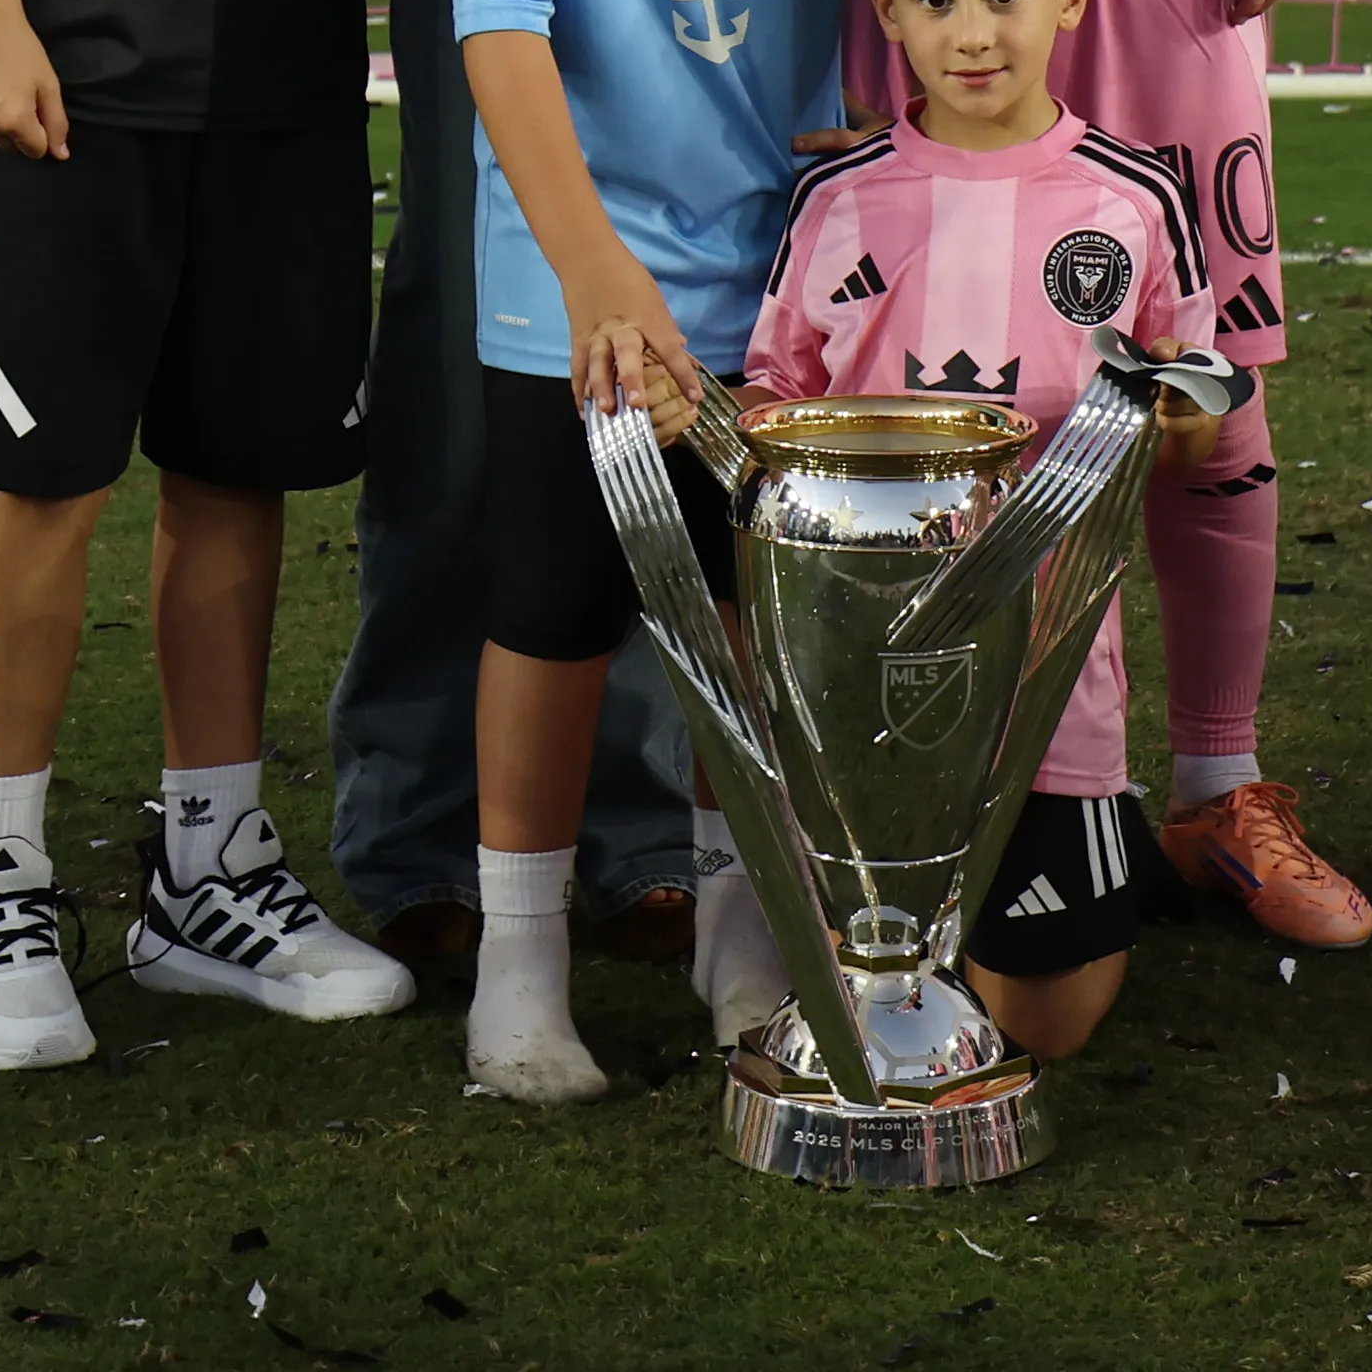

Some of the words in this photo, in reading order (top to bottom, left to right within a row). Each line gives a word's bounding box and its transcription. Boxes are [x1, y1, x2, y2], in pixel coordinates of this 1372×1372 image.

[1047, 234, 1120, 270] INTERNACIONAL
[1072, 255, 1109, 266] MIAMI
[1118, 254, 1129, 266] DE
[1046, 274, 1059, 301] CLUB
[1071, 312, 1099, 323] MMXX
[889, 664, 940, 687] MLS
[858, 1122, 901, 1131] MAJOR
[792, 1129, 842, 1149] 2025
[849, 1138, 894, 1151] MLS
